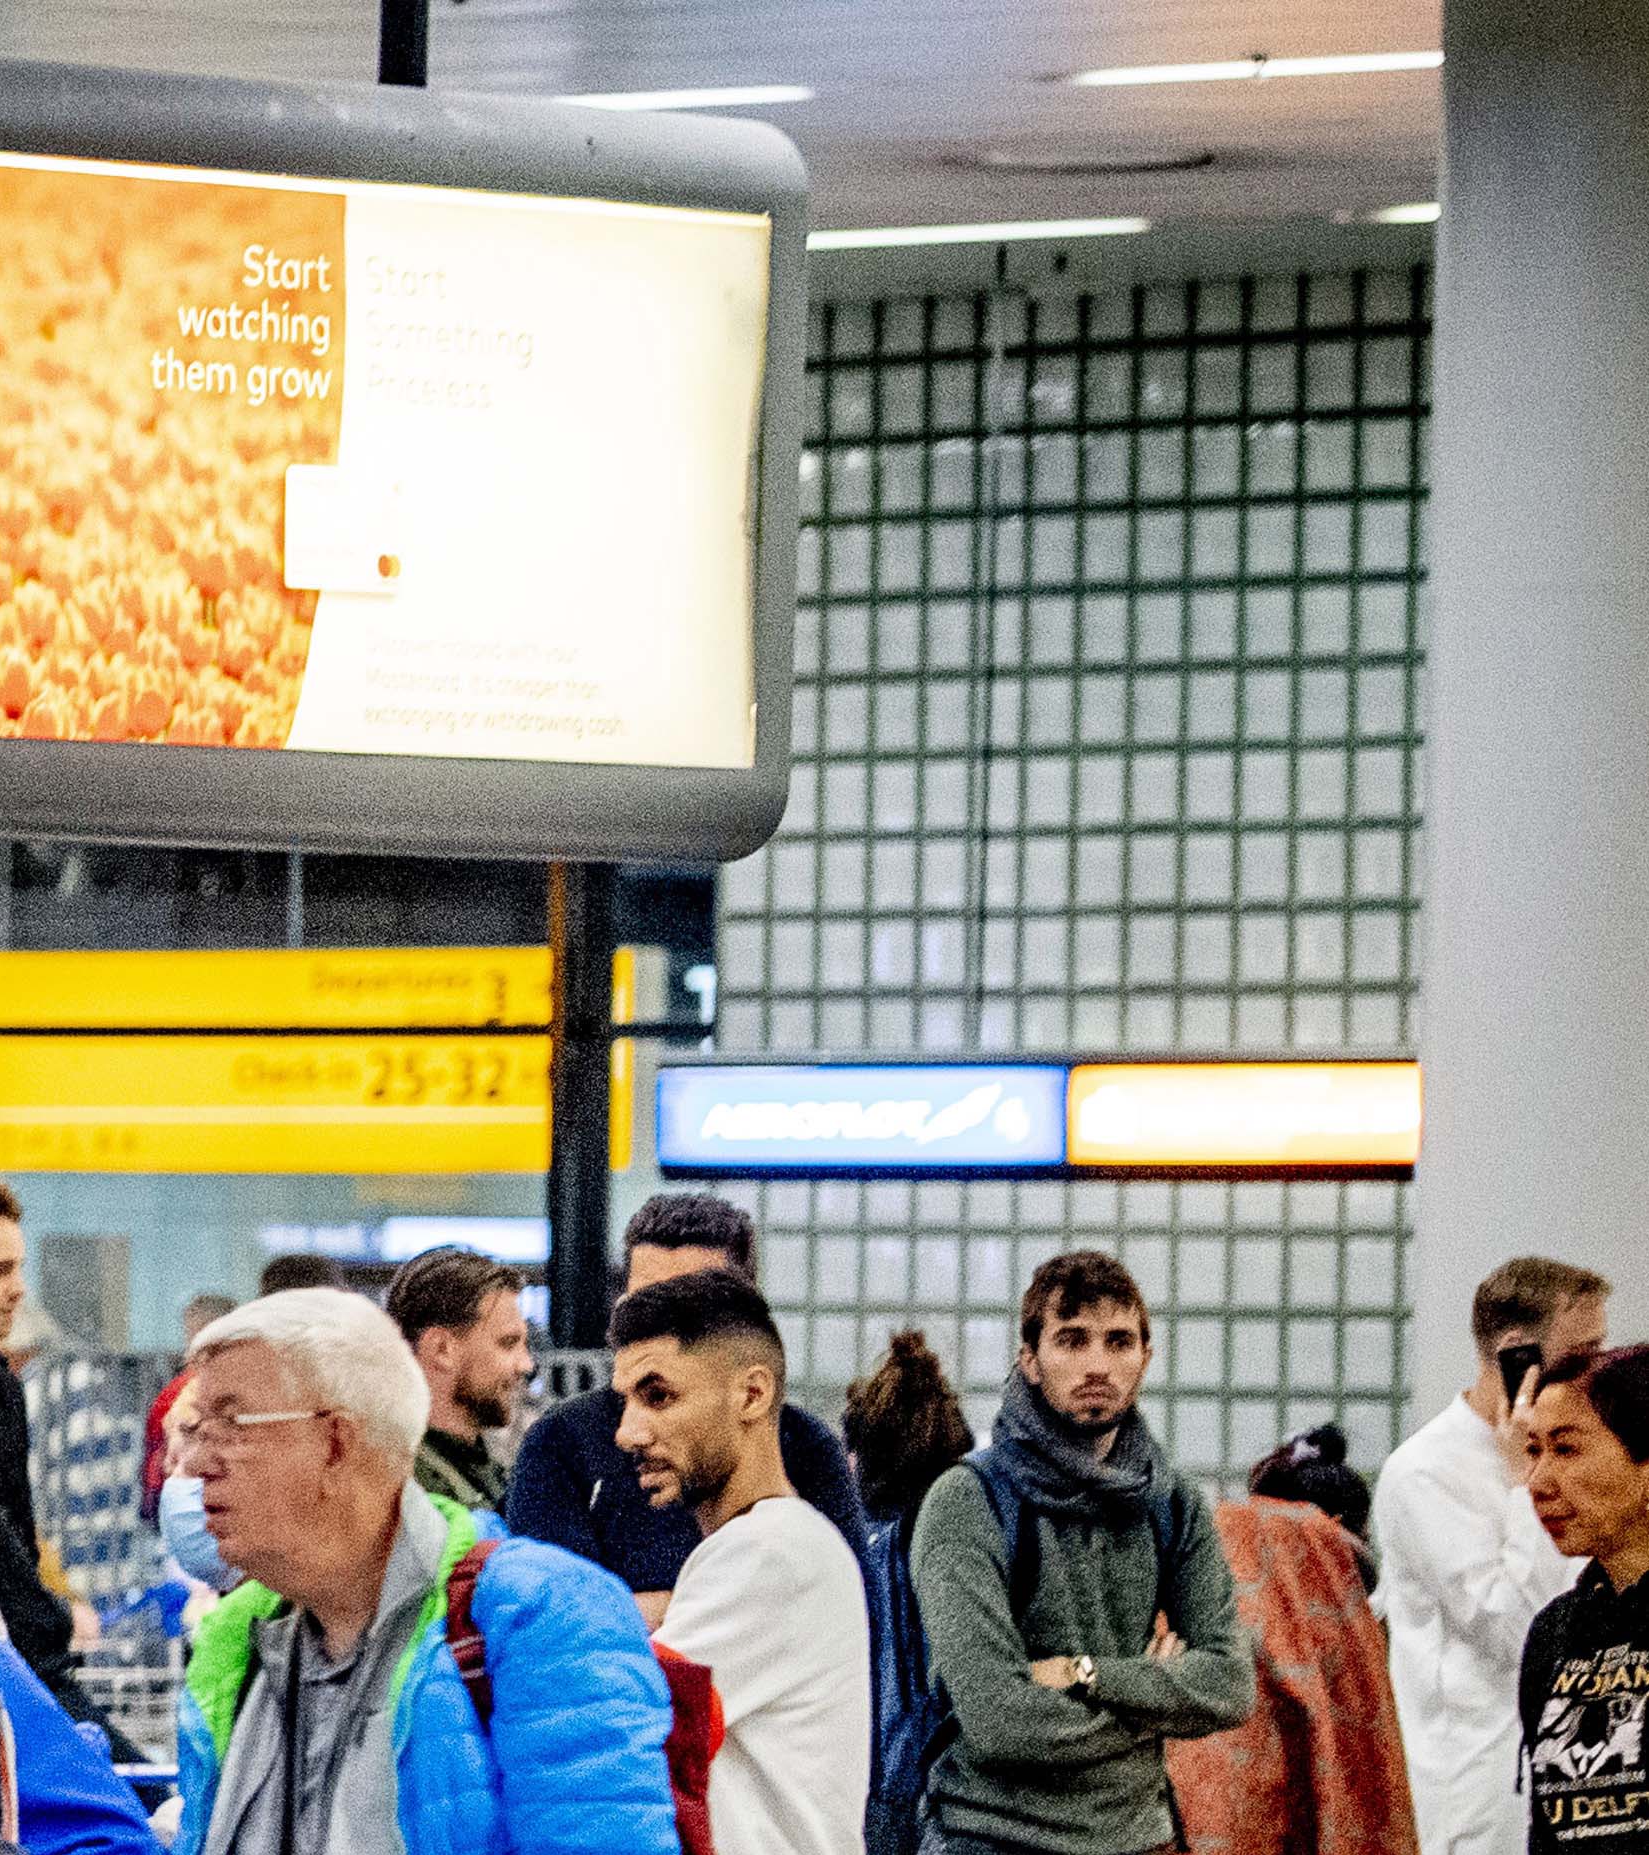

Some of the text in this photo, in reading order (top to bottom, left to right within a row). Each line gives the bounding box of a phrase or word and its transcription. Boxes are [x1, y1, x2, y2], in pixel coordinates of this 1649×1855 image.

[242, 243, 332, 293] Start
[177, 299, 331, 357] watching
[150, 348, 334, 407] them grow
